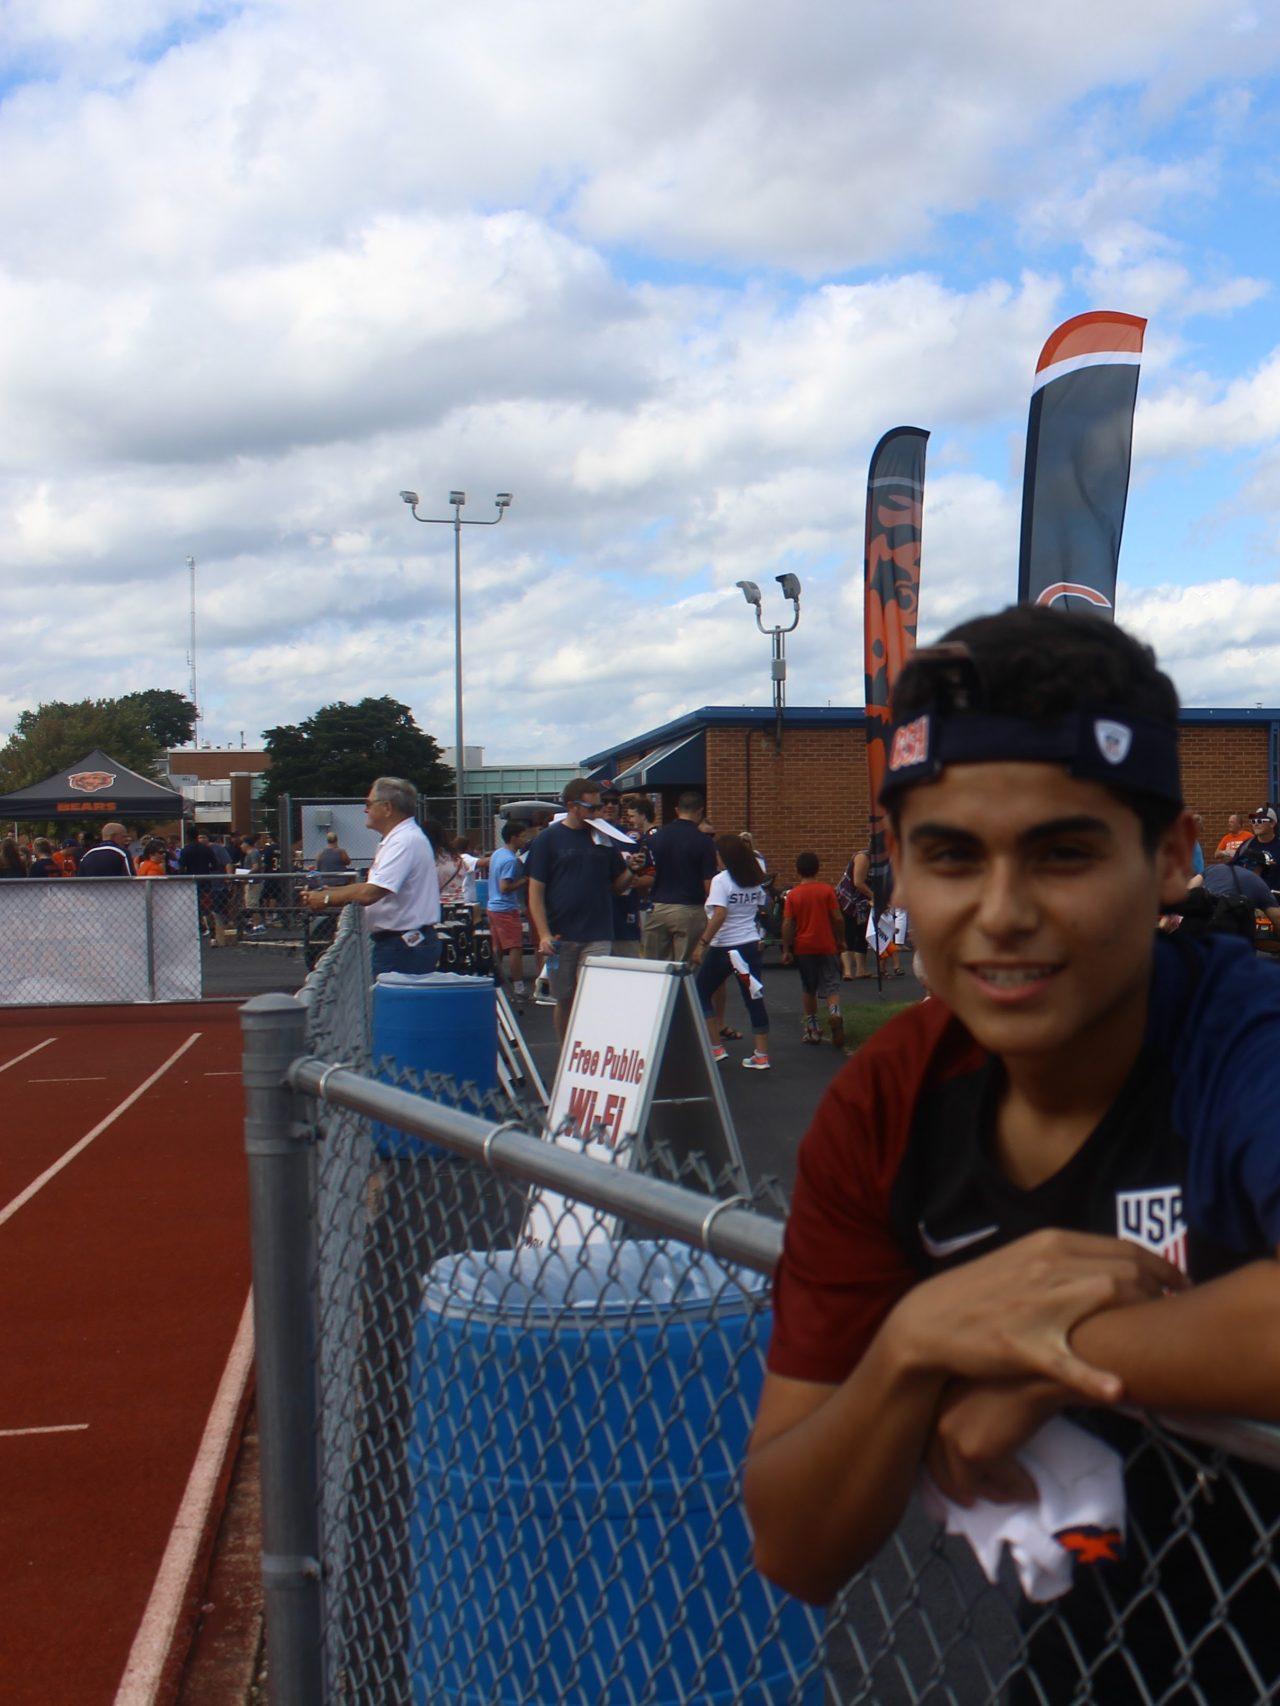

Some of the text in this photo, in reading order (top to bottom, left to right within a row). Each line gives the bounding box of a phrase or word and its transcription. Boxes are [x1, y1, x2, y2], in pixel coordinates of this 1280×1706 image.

[56, 801, 117, 812] BEARS
[728, 892, 758, 904] STAF
[568, 1040, 645, 1085] Free Public
